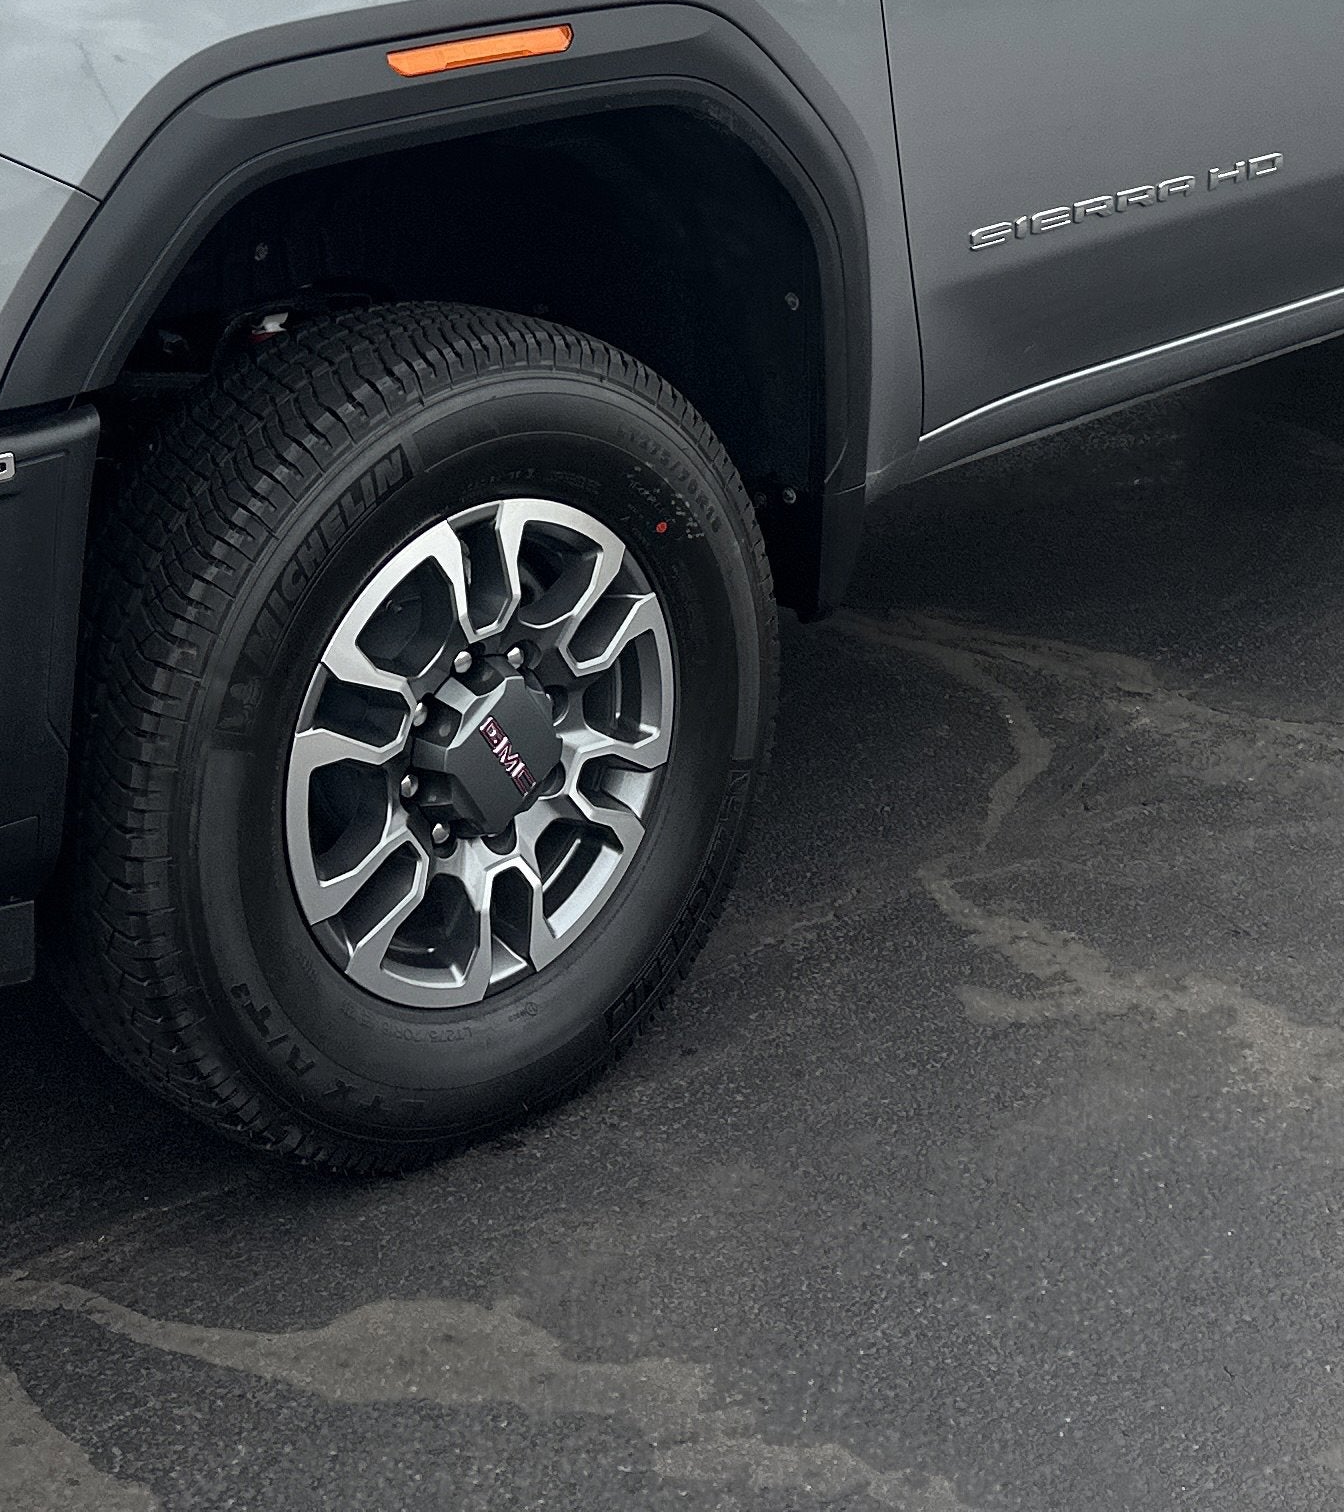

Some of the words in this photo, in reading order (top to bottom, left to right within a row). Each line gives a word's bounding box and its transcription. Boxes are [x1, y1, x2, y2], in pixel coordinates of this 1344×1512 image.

[968, 175, 1196, 251] SIERRA
[1208, 152, 1284, 190] HD
[234, 444, 407, 674] MICHELIN
[479, 716, 537, 798] GMC
